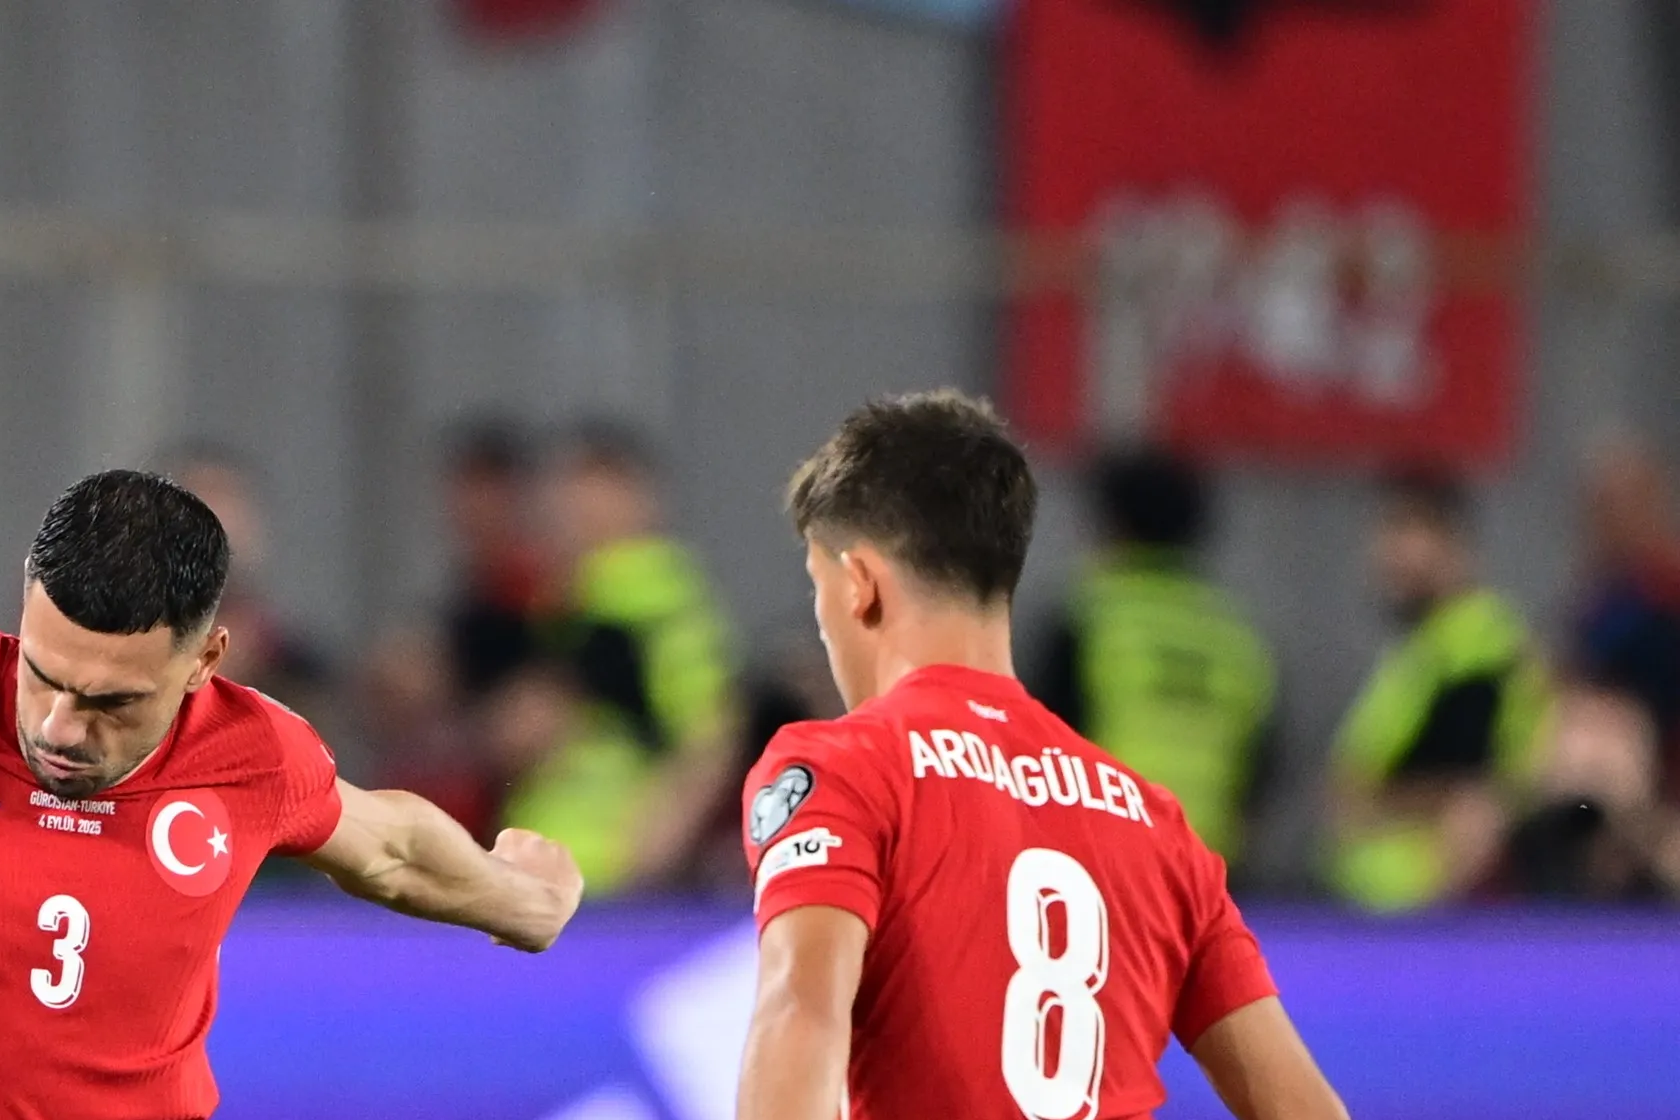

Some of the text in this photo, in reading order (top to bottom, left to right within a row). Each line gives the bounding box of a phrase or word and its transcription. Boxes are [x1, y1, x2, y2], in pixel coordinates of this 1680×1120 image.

[77, 818, 102, 835] 2025
[909, 729, 1154, 828] ARDAGÜLER
[30, 894, 90, 1009] 3
